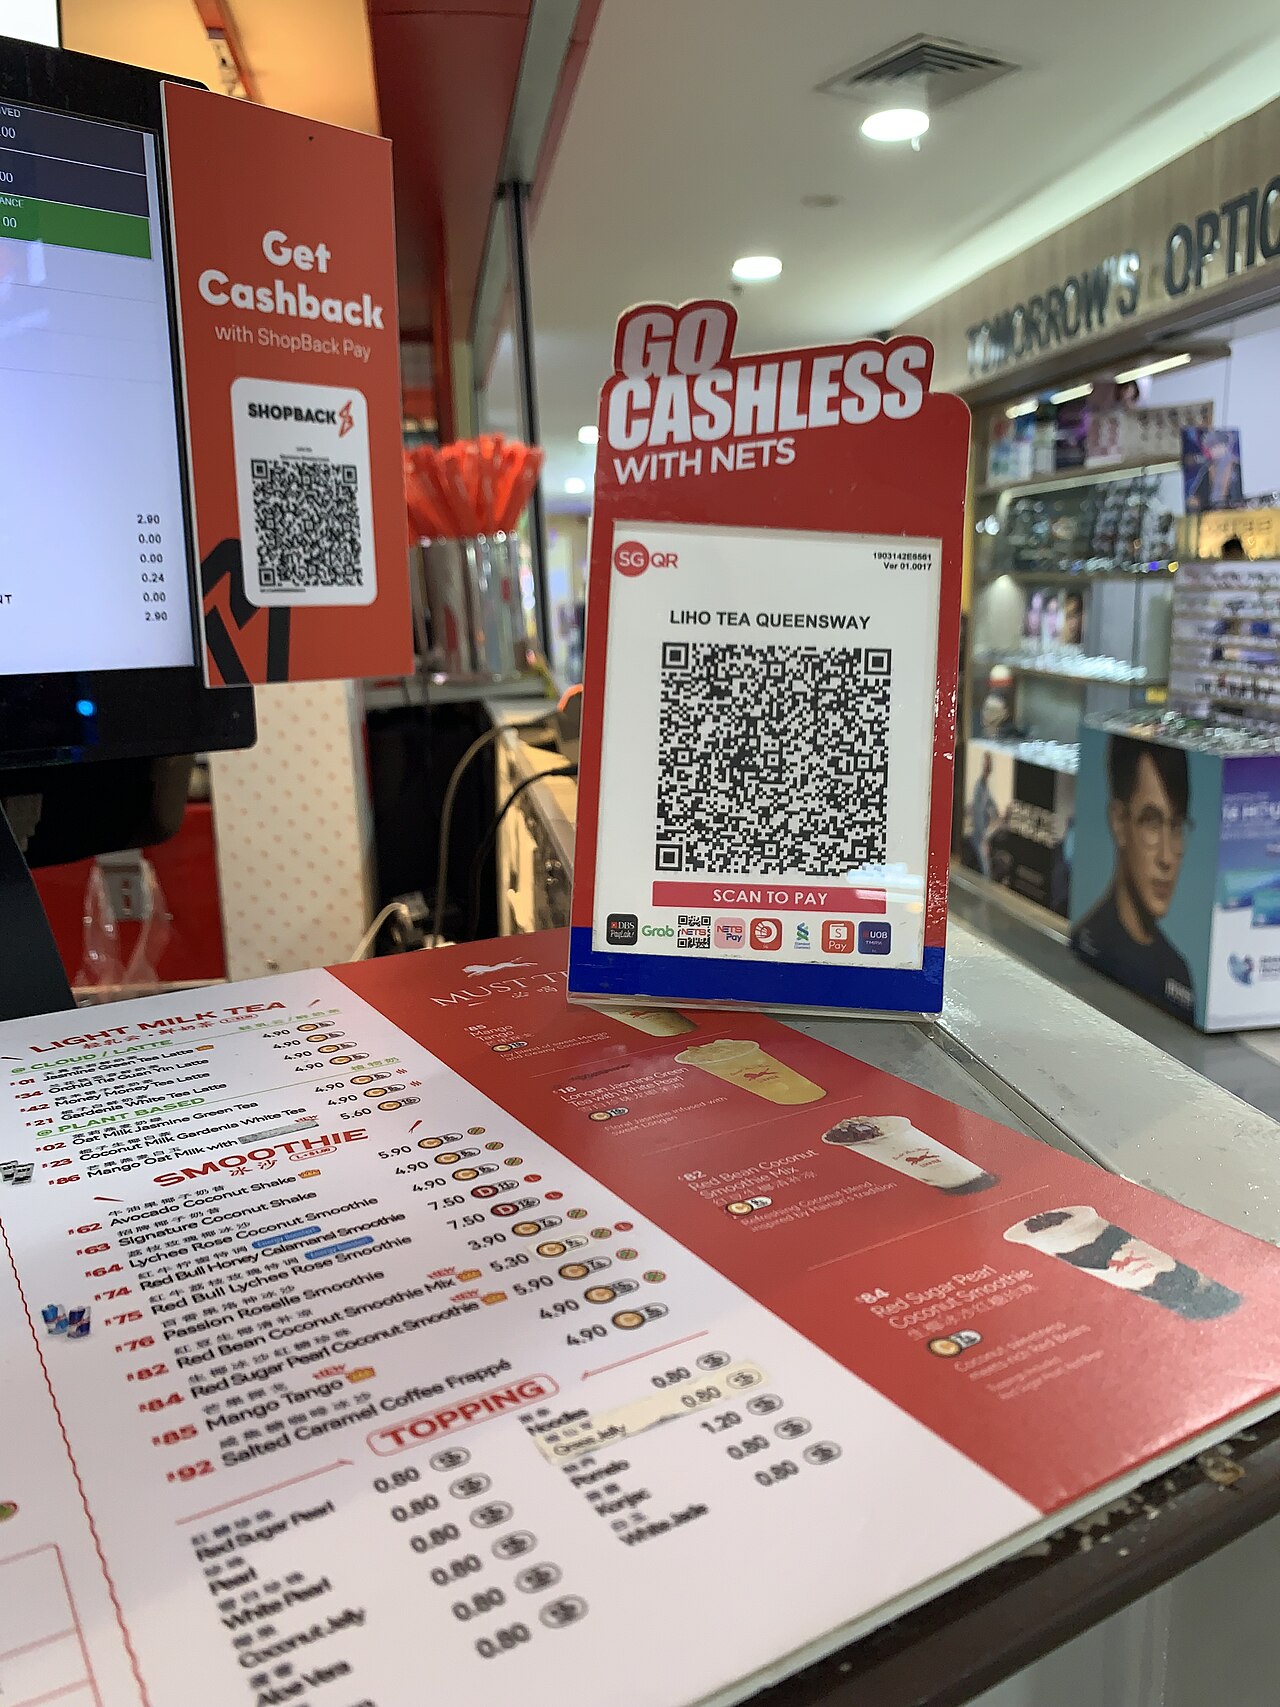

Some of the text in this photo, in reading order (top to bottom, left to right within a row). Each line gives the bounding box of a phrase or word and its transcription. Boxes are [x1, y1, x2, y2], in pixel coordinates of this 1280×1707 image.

[262, 230, 332, 274] Get
[198, 269, 385, 330] Cashback
[215, 324, 371, 363] with ShopBack Pay
[622, 307, 729, 378] GO
[248, 402, 337, 425] SHOPBACK
[607, 345, 927, 451] CASHLESS
[613, 437, 797, 486] WITH NETS
[137, 513, 160, 525] 2.90
[138, 533, 162, 545] 0.00
[139, 553, 163, 564] 0.00
[141, 572, 165, 584] 0.24
[884, 562, 932, 572] Ver 01.0017
[143, 592, 166, 603] 0.00
[145, 611, 168, 622] 2.90
[670, 610, 871, 631] LIHO TEA QUEENSWAY
[713, 888, 829, 906] SCAN TO PAY
[618, 921, 635, 929] DBS
[641, 925, 675, 938] Grab
[829, 942, 847, 952] Pay
[870, 930, 888, 939] UOB
[430, 977, 528, 1007] MUST
[29, 1026, 129, 1053] LIGHT
[137, 1011, 218, 1031] MILK
[223, 1001, 287, 1018] TEA
[470, 1025, 513, 1038] Mango
[30, 1053, 97, 1072] CLOUD
[115, 1039, 173, 1053] LATTE
[43, 1066, 96, 1082] Jasmine
[98, 1060, 138, 1072] Green
[161, 1049, 194, 1059] Latte
[262, 1029, 291, 1039] 4.90
[48, 1080, 93, 1095] Orchid
[118, 1069, 152, 1081] Guan
[176, 1059, 209, 1071] Latte
[273, 1039, 301, 1050] 4.90
[55, 1092, 102, 1107] Money
[104, 1082, 150, 1098] Money
[176, 1072, 210, 1084] Latte
[284, 1050, 313, 1061] 4.90
[61, 1062, 324, 1121] Gardenia White Latte 4.90
[560, 1087, 608, 1101] Longan
[653, 1066, 690, 1080] Green
[58, 1097, 207, 1134] PLANT BASED
[72, 1082, 345, 1147] Oat Milk Jasmine Green 4.90
[79, 1094, 359, 1162] Coconut Milk Gardenia White Tea 4.90
[87, 1161, 141, 1178] Mango
[143, 1152, 174, 1165] Oat
[174, 1147, 206, 1160] Milk
[205, 1138, 239, 1152] with
[340, 1107, 372, 1121] 5.60
[153, 1128, 369, 1187] SMOOTHIE
[110, 1145, 413, 1228] Avocado Coconut Shake 5.90
[687, 1176, 721, 1192] Red
[721, 1163, 760, 1182] Bean
[758, 1149, 820, 1171] Coconut
[699, 1175, 769, 1201] Smoothie
[118, 1161, 429, 1248] Signature Coconut Shake 4.90
[128, 1177, 447, 1270] Lychee Rose Coconut Smoothie 4.90
[139, 1274, 174, 1292] Red
[175, 1265, 206, 1283] Bull
[208, 1253, 259, 1274] Honey
[261, 1232, 337, 1258] Calamansi
[337, 1211, 406, 1236] Smoothie
[427, 1195, 466, 1212] 7.50
[150, 1297, 188, 1315] Red
[191, 1286, 226, 1304] Bull
[229, 1270, 290, 1294] Lychee
[292, 1258, 334, 1276] Rose
[335, 1235, 413, 1264] Smoothie
[446, 1213, 486, 1231] 7.50
[162, 1232, 507, 1341] Passion Roselle Smoothie 3.90
[175, 1253, 529, 1370] Red Bean Coconut Smoothie Mix 5.30
[870, 1263, 999, 1318] Red Sugar Pearl
[889, 1297, 958, 1331] Coconut
[956, 1267, 1035, 1303] Smoothie
[190, 1378, 231, 1400] Red
[230, 1363, 285, 1389] Sugar
[286, 1347, 332, 1369] Pearl
[332, 1326, 401, 1354] Coconut
[401, 1301, 480, 1331] Smoothie
[512, 1274, 554, 1297] 5.90
[205, 1399, 281, 1433] Mango
[280, 1379, 344, 1406] Tango
[539, 1299, 581, 1321] 4.90
[380, 1382, 446, 1413] Coffee
[566, 1324, 608, 1347] 4.90
[379, 1379, 546, 1448] TOPPING
